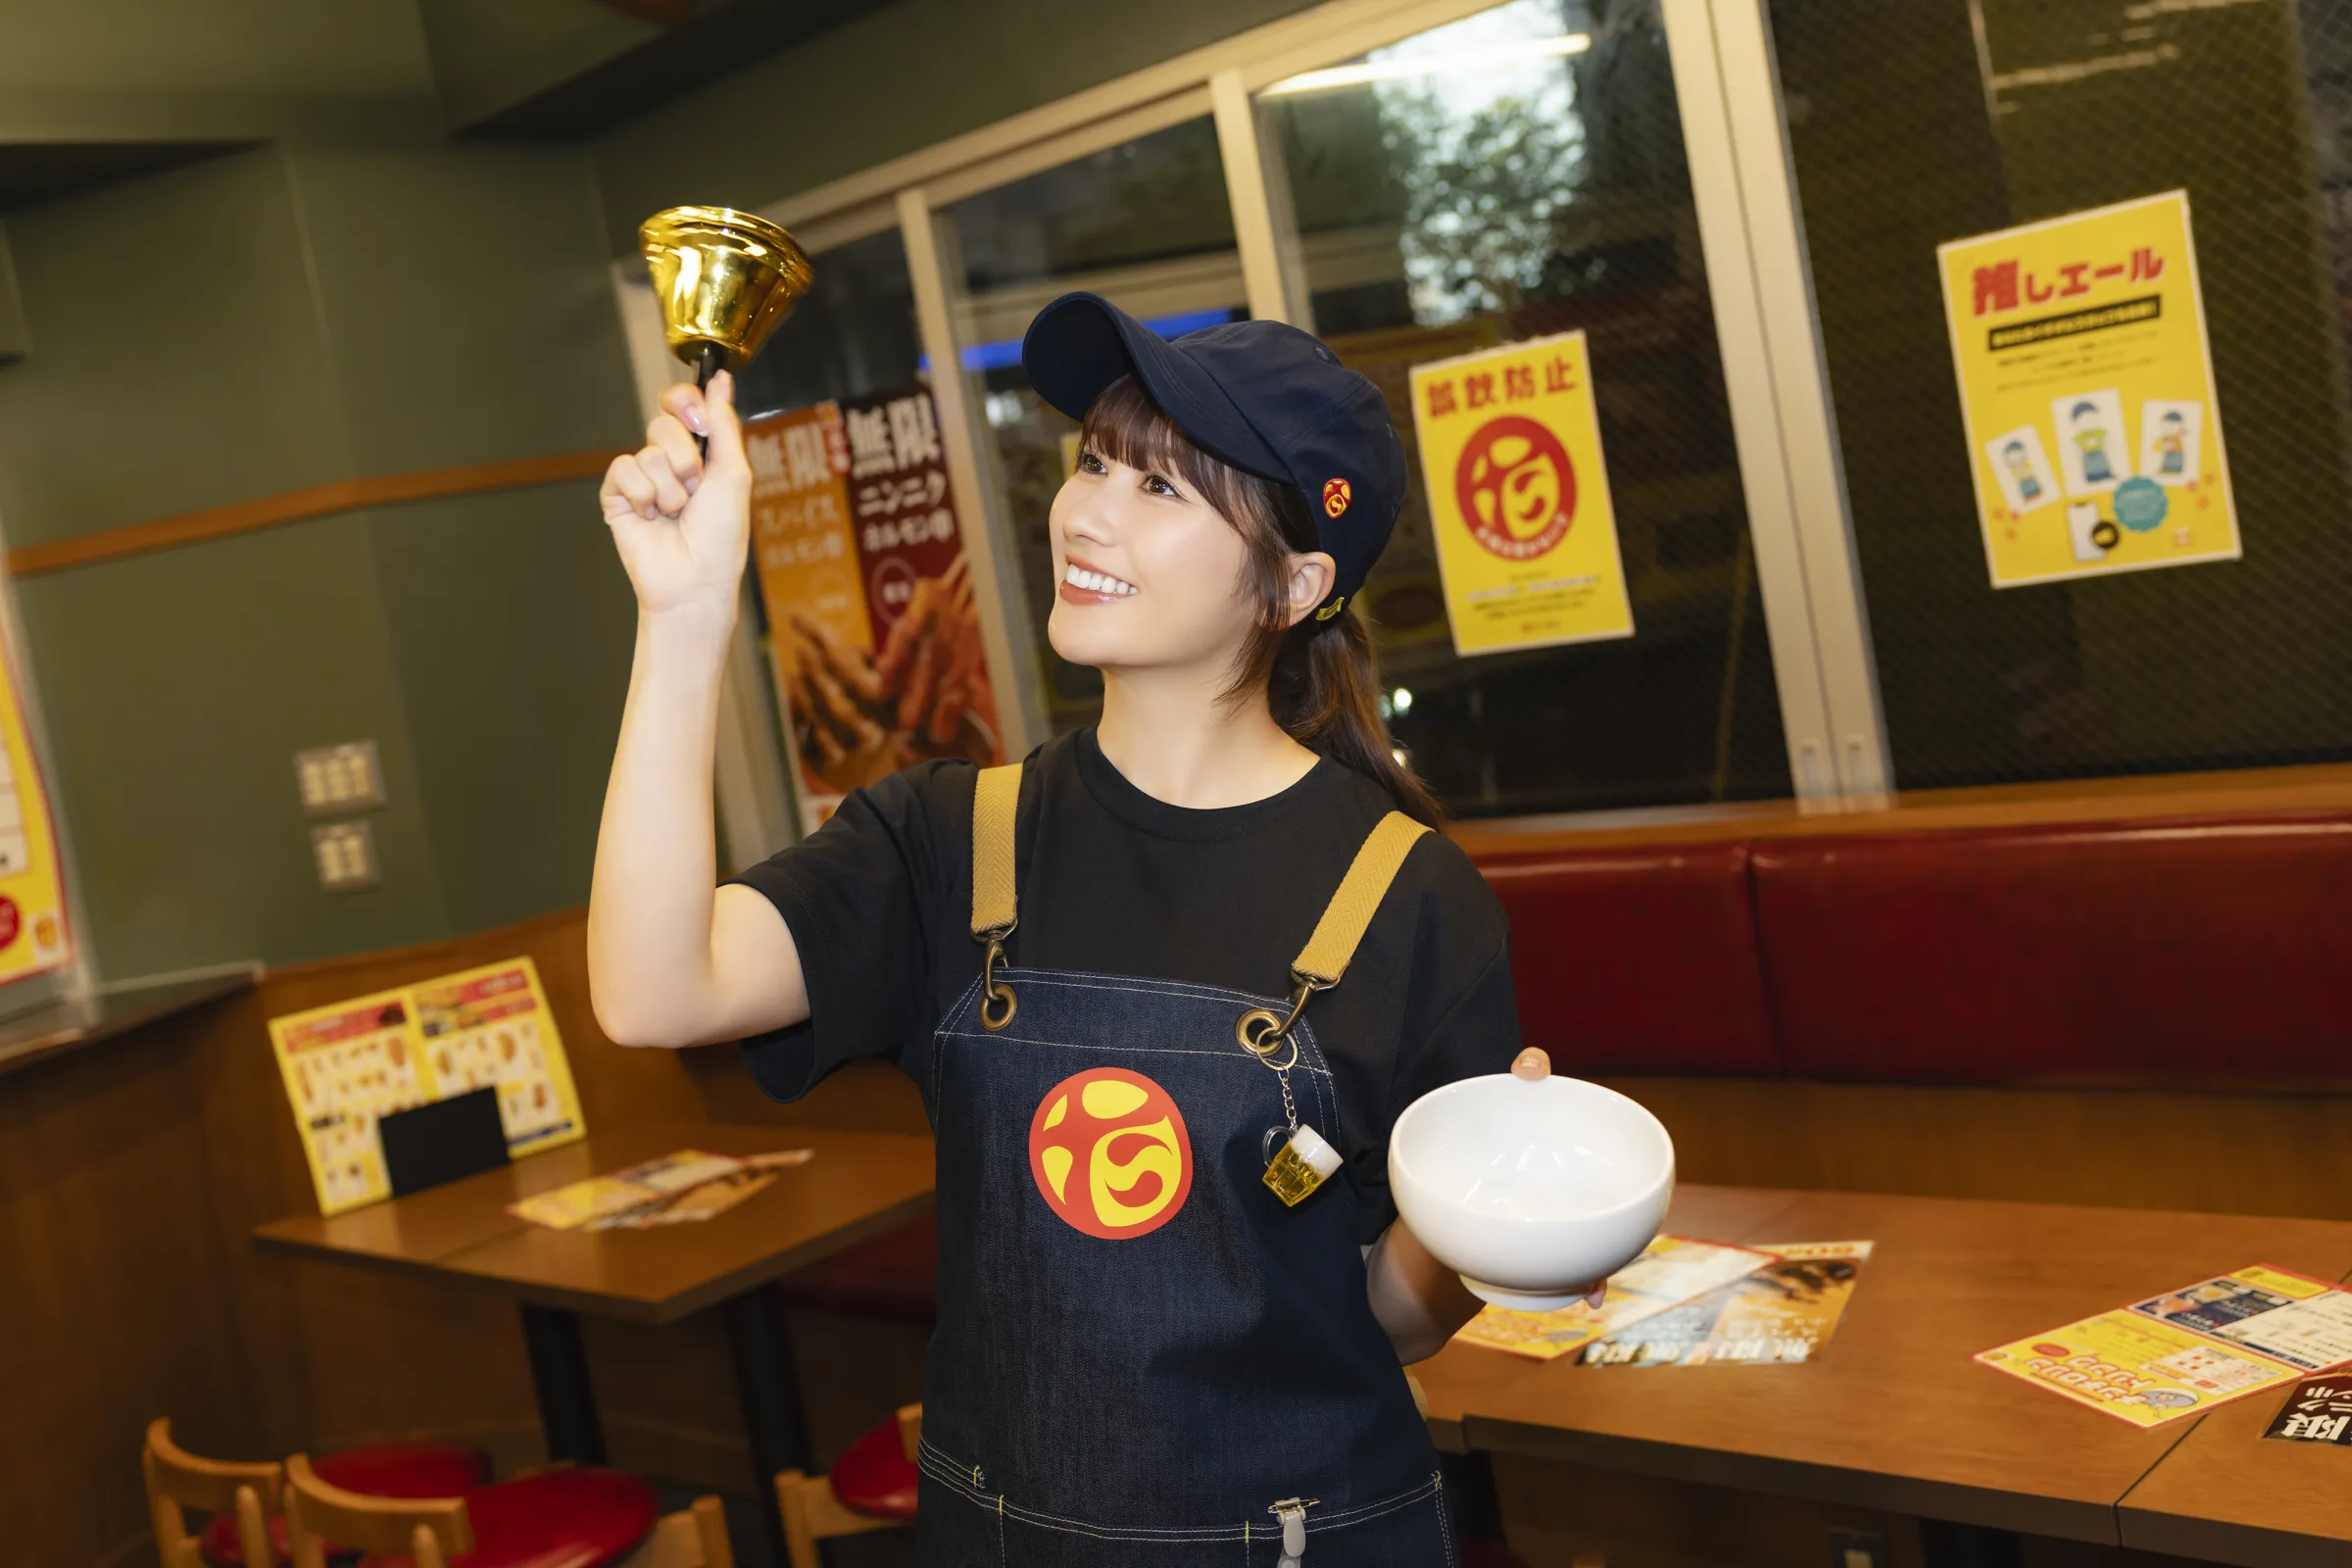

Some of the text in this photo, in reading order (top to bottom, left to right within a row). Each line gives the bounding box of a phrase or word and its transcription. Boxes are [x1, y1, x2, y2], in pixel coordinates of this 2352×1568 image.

[1972, 246, 2164, 318] 推しエール
[846, 393, 940, 480] 無限
[858, 470, 946, 517] ニンニク
[2281, 1412, 2352, 1441] 限
